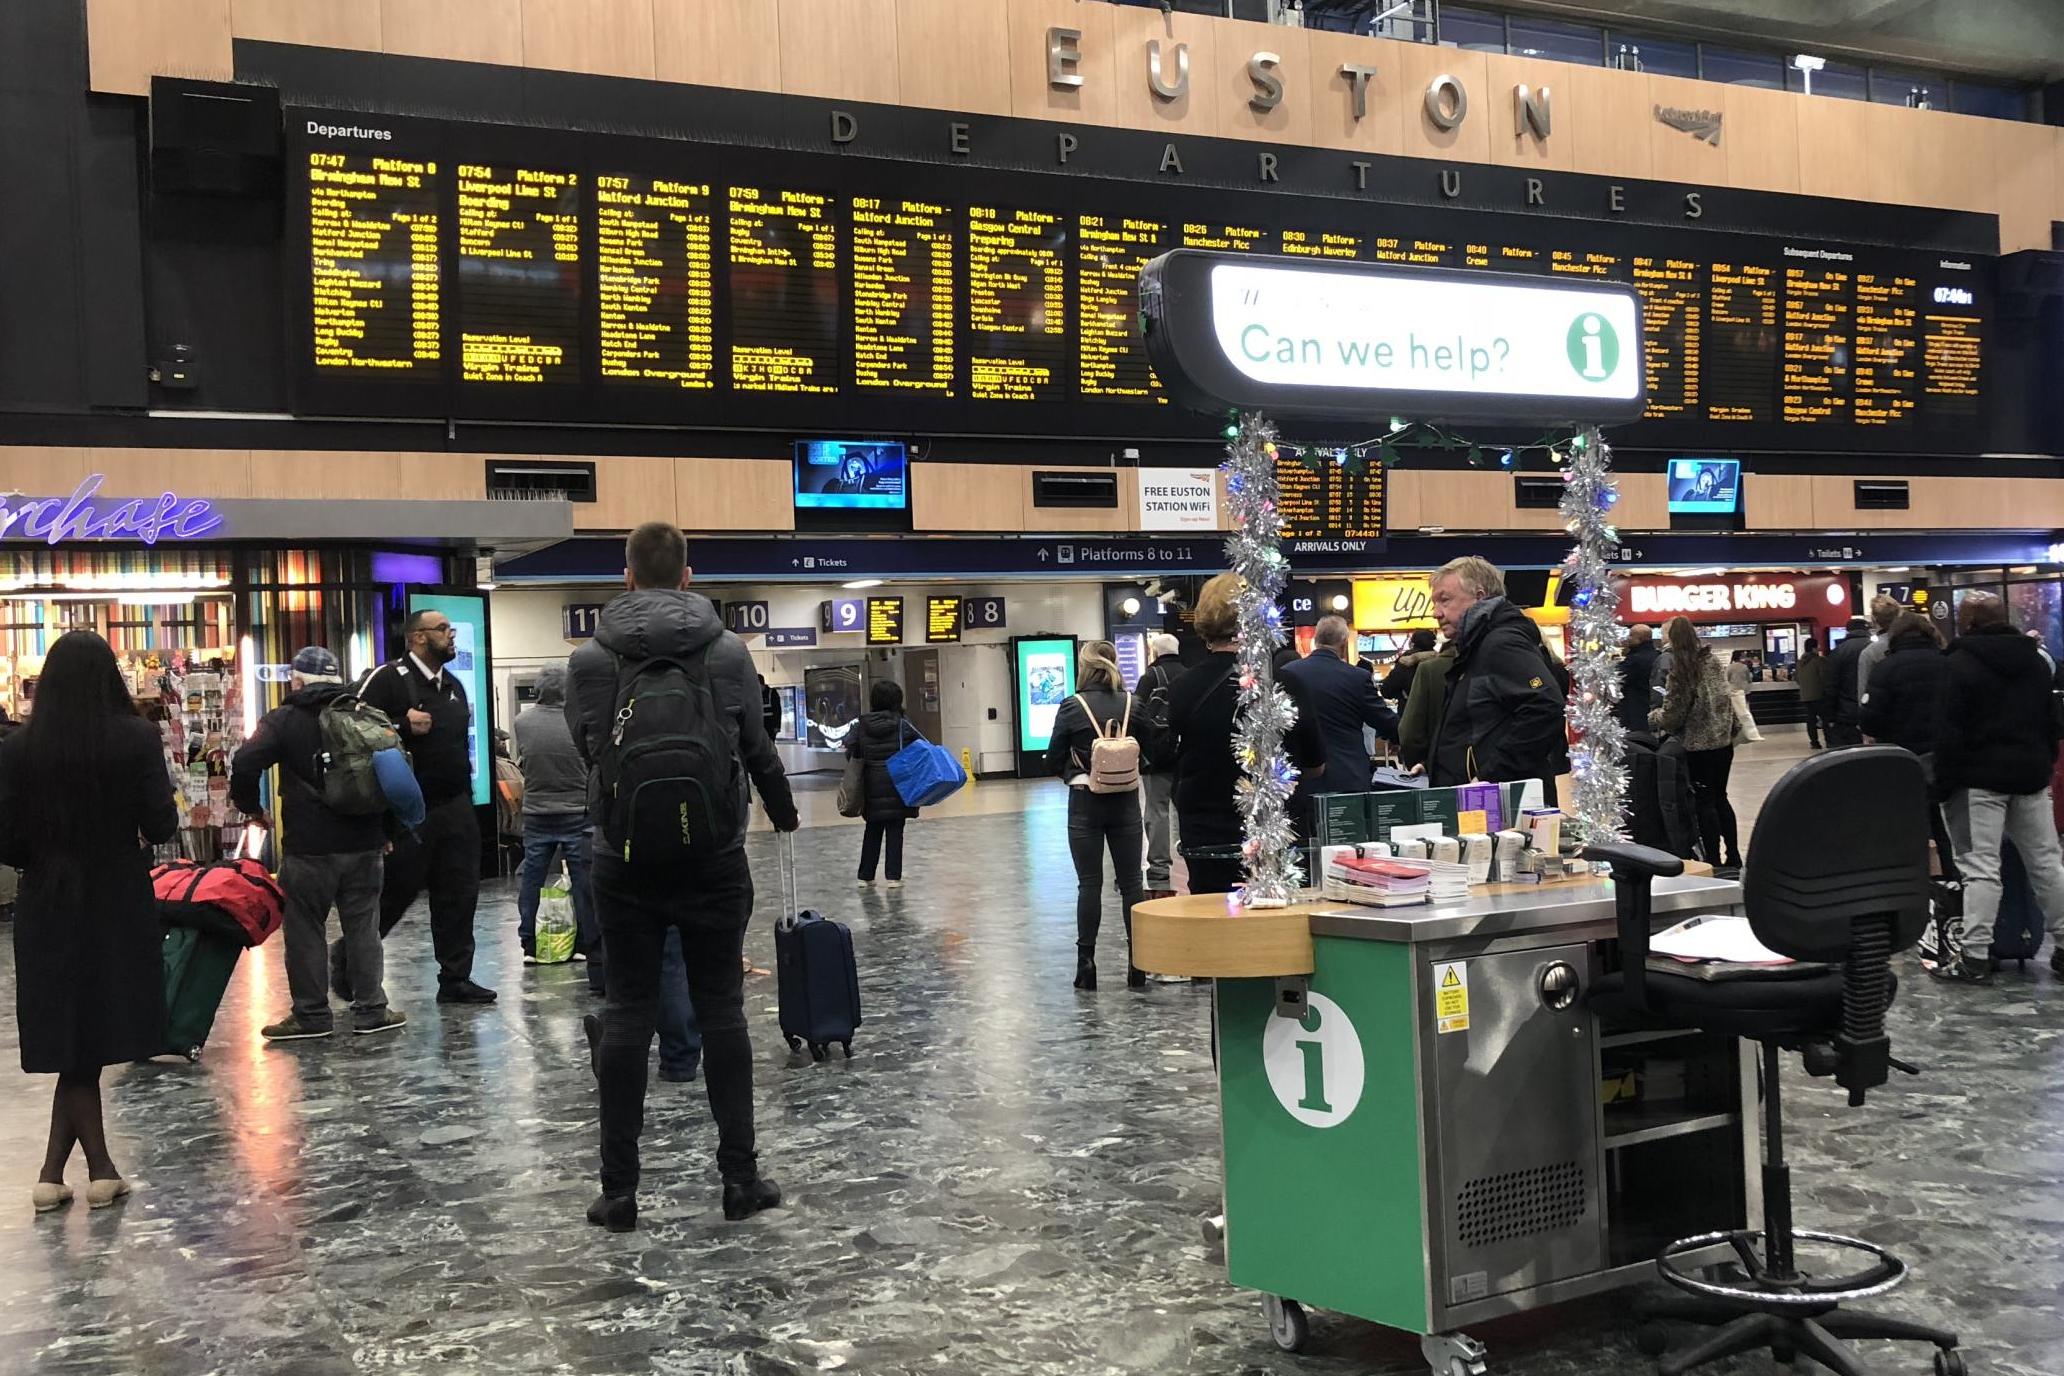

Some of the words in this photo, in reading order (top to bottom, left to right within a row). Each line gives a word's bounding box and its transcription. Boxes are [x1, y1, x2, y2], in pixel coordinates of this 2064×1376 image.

[1047, 27, 1551, 142] EUSTON
[307, 121, 392, 140] Departures
[310, 154, 345, 167] 07:47
[373, 158, 423, 173] Platform
[831, 110, 1702, 218] DEPARTURES
[311, 169, 375, 184] Birmingham
[379, 174, 402, 186] New
[407, 176, 421, 188] St
[458, 165, 491, 179] 07:54
[517, 170, 564, 184] Platform
[569, 174, 576, 185] 2
[459, 180, 511, 195] Liverpool
[515, 184, 539, 196] Lime
[544, 187, 557, 198] St
[598, 176, 629, 189] 07:57
[653, 181, 698, 195] Platform
[702, 185, 709, 196] 9
[326, 189, 376, 199] Northampton
[598, 191, 641, 204] Watford
[645, 195, 689, 208] Junction
[730, 187, 758, 199] 07:59
[782, 191, 824, 204] Platform
[312, 198, 345, 208] Boarding
[459, 195, 509, 210] Boarding
[730, 201, 783, 215] Birmingham
[788, 206, 806, 217] New
[810, 208, 821, 218] St
[853, 197, 880, 209] 08:17
[902, 202, 942, 214] Platform
[312, 208, 337, 218] Calling
[393, 213, 411, 223] Page
[413, 214, 417, 222] 1
[460, 209, 484, 218] Calling
[536, 213, 553, 223] Page
[853, 211, 890, 223] Watford
[895, 214, 933, 227] Junction
[970, 207, 995, 218] 08:18
[1016, 211, 1053, 223] Platform
[970, 221, 1004, 232] Glasgow
[1008, 223, 1041, 235] Central
[1080, 216, 1103, 226] 08:21
[1123, 219, 1158, 231] Platform
[313, 228, 345, 237] Watford
[348, 230, 381, 239] Junction
[460, 228, 494, 237] Stafford
[1080, 229, 1120, 240] Birmingham
[1123, 232, 1136, 241] New
[1140, 233, 1148, 242] St
[1184, 224, 1207, 234] 08:26
[1225, 227, 1259, 238] Platform
[1283, 231, 1305, 241] 08:30
[1322, 234, 1354, 245] Platform
[461, 237, 490, 246] Runcorn
[970, 233, 1014, 247] Preparing
[1184, 237, 1230, 248] Manchester
[1234, 239, 1249, 249] Picc
[1377, 238, 1398, 248] 08:37
[1414, 241, 1445, 251] Platform
[469, 247, 503, 257] Liverpool
[524, 250, 533, 259] St
[1283, 244, 1320, 256] Edinburgh
[1324, 248, 1356, 257] Waverley
[1377, 251, 1406, 259] Watford
[1409, 253, 1438, 263] Junction
[1503, 247, 1532, 257] Platform
[1552, 251, 1572, 260] 08:45
[1587, 254, 1615, 263] Platform
[1784, 247, 1819, 258] Subsequent
[1820, 250, 1853, 260] Departures
[1466, 257, 1488, 266] Crewe
[1552, 263, 1590, 272] Manchester
[1593, 265, 1607, 273] Picc
[1940, 260, 1971, 270] Information
[462, 333, 506, 342] Reservation
[1240, 324, 1321, 365] Can
[1338, 340, 1393, 368] we
[1410, 333, 1510, 380] help?
[316, 357, 348, 365] London
[352, 358, 412, 367] Northwestern
[463, 363, 499, 372] Virgin
[504, 364, 539, 372] Trains
[602, 368, 639, 376] London
[644, 369, 705, 379] Overground
[1145, 487, 1168, 496] FREE
[1171, 487, 1210, 496] EUSTON
[1146, 502, 1187, 511] STATION
[1190, 502, 1210, 511] WiFi
[1295, 542, 1339, 552] ARRIVALS
[1342, 542, 1366, 550] ONLY
[1082, 548, 1144, 561] Platforms
[1148, 548, 1155, 560] 8
[1160, 549, 1172, 560] to
[1177, 548, 1192, 560] 11
[1631, 584, 1730, 612] BURGER
[1734, 584, 1795, 609] KING
[1900, 587, 1909, 602] 7
[739, 604, 766, 628] 10
[840, 603, 856, 626] 9
[985, 602, 998, 622] 8
[575, 608, 599, 631] 11
